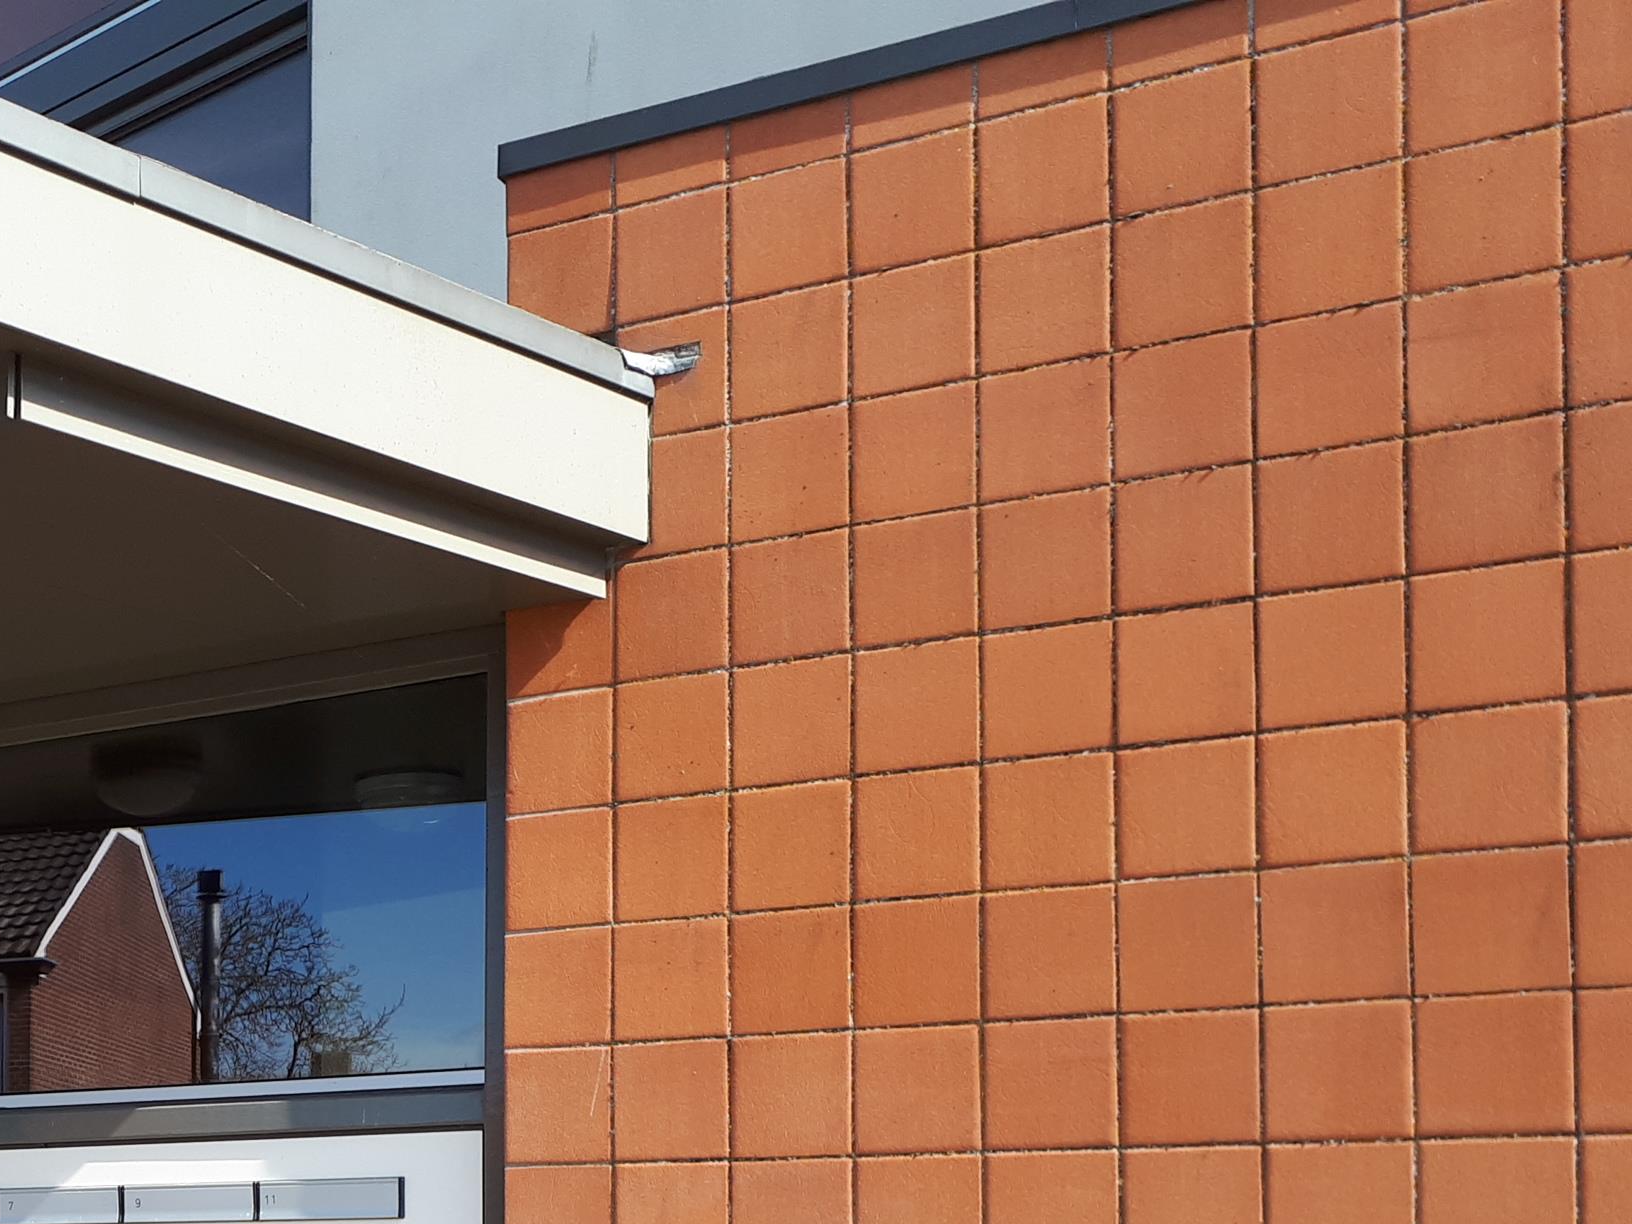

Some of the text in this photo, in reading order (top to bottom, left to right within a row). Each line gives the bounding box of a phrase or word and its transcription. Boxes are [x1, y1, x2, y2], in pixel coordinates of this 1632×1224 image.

[134, 1198, 142, 1209] 9
[264, 1194, 276, 1205] 11
[8, 1200, 14, 1211] 7
